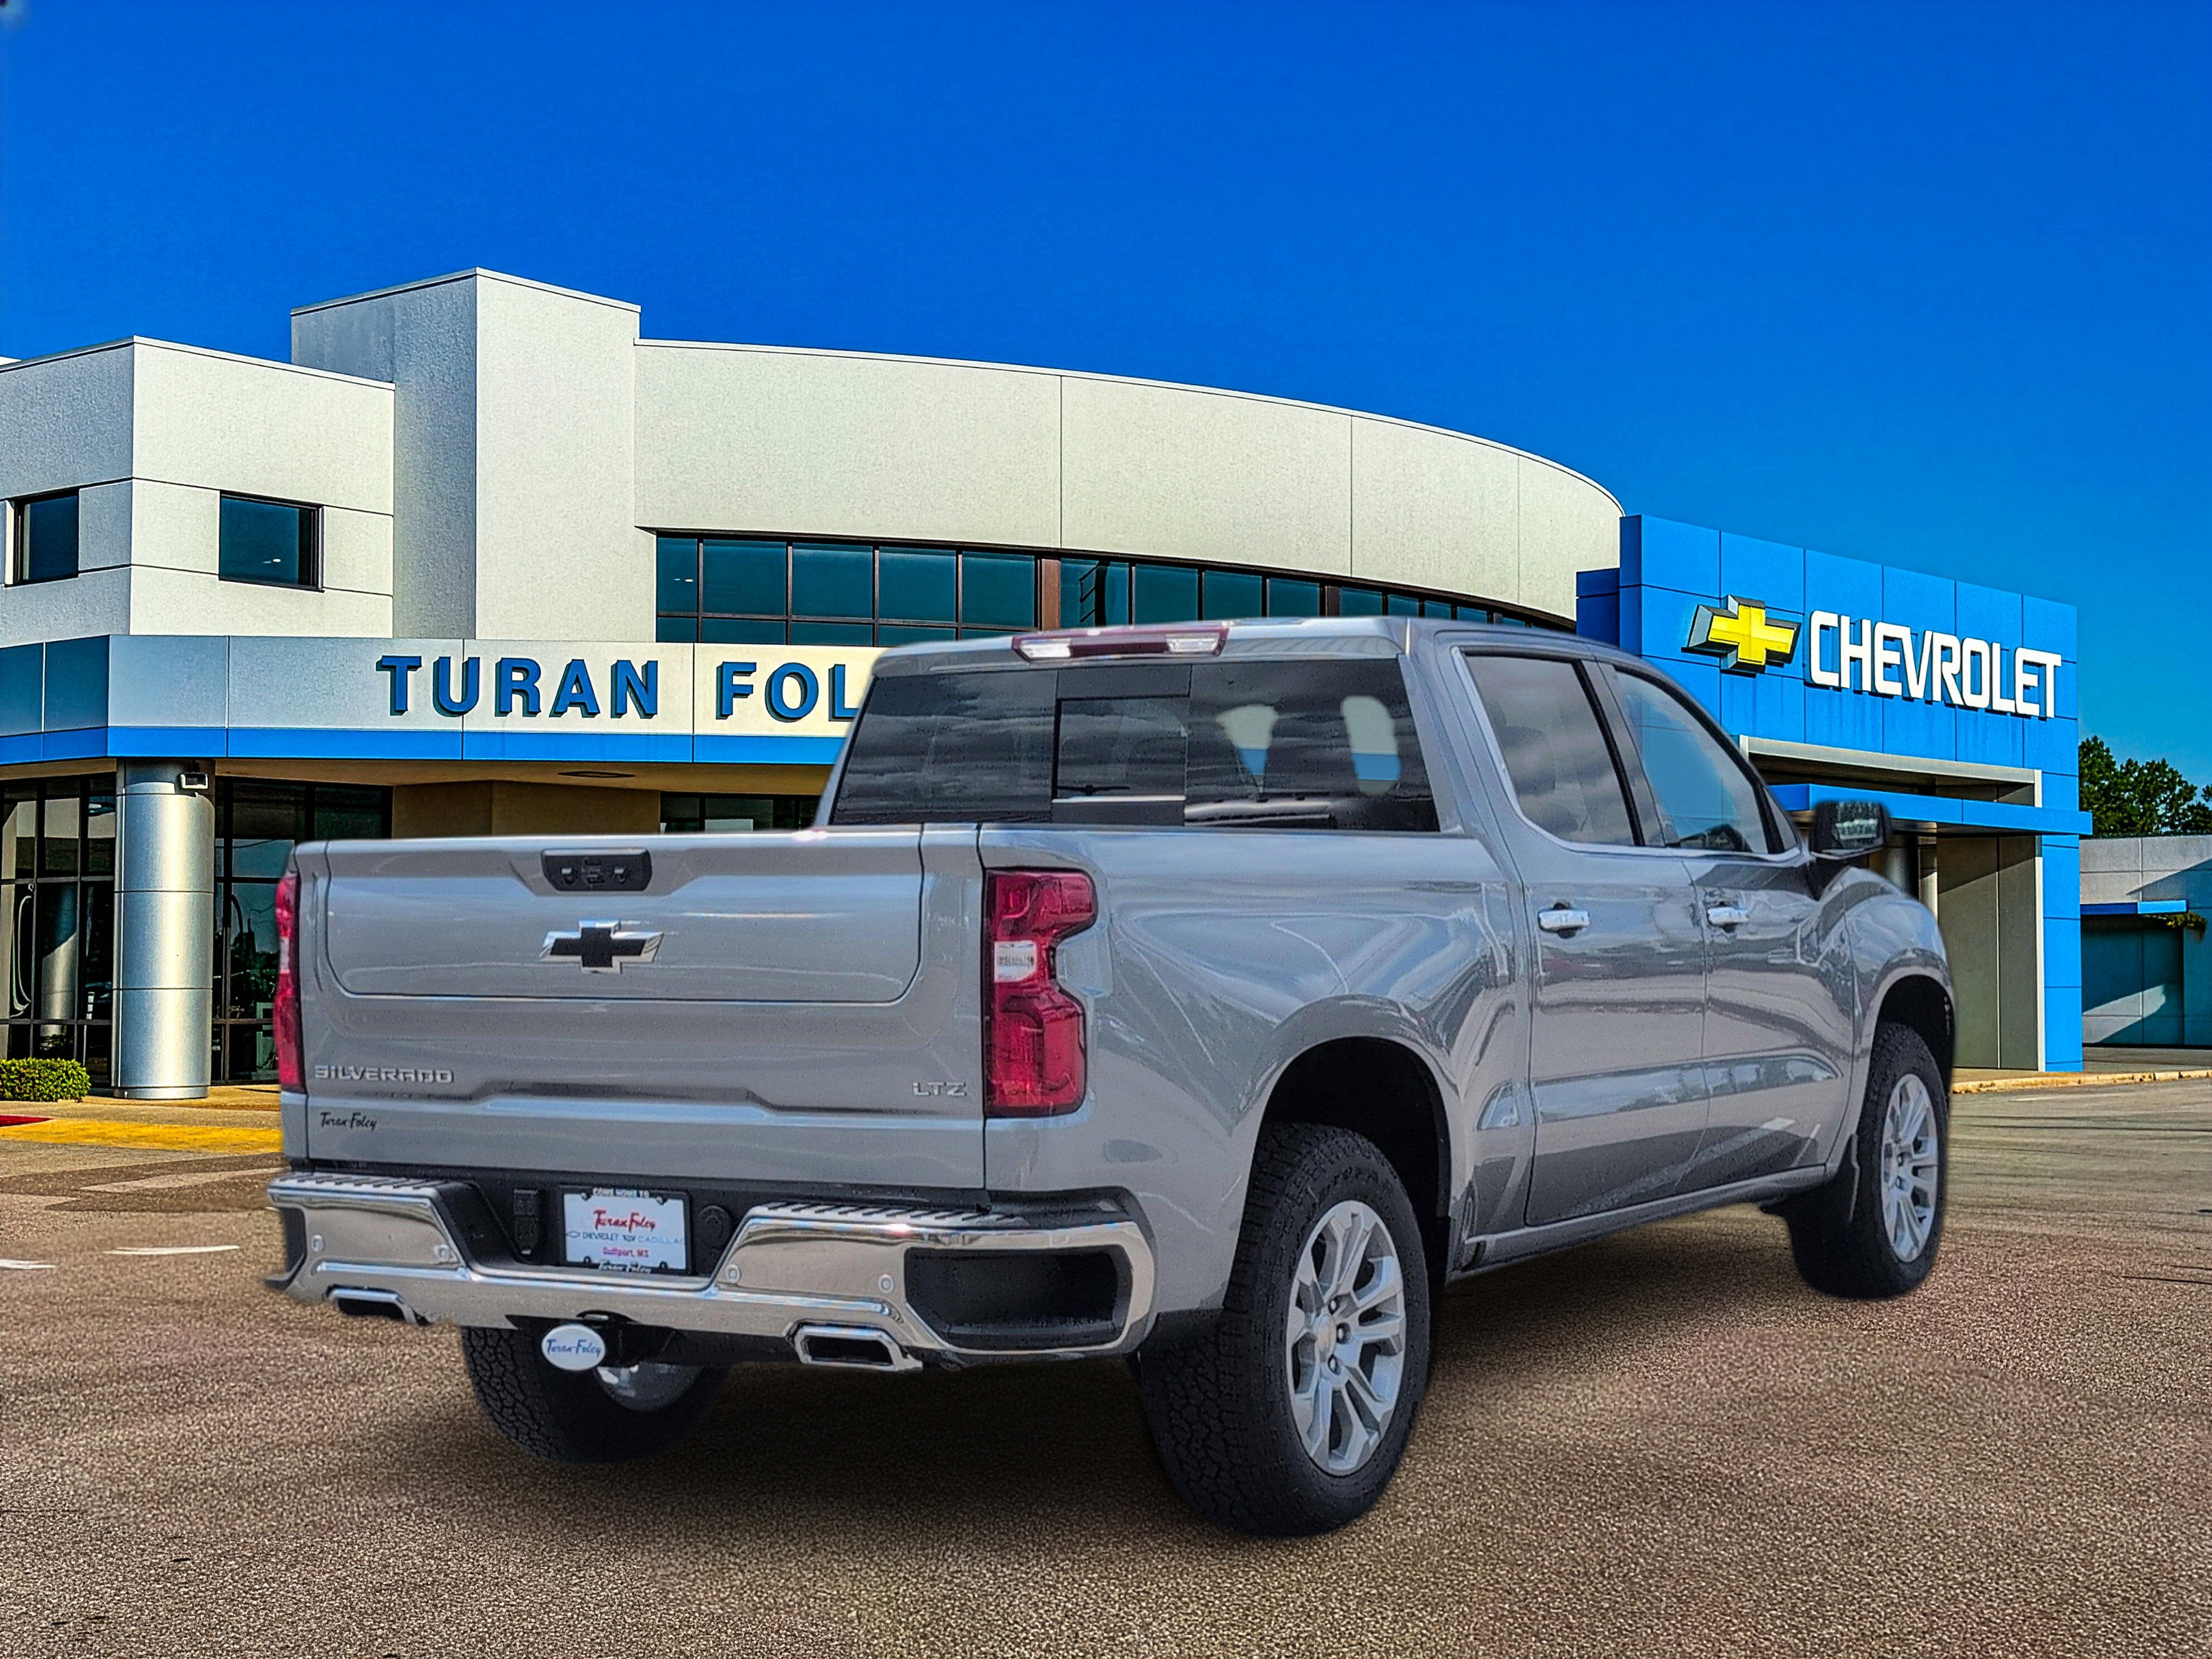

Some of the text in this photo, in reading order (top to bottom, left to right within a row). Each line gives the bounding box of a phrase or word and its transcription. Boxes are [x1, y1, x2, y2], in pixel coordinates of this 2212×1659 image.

[1808, 610, 2062, 719] CHEVROLET
[376, 655, 861, 722] TURAN FOL
[314, 1065, 454, 1083] SILVERADO
[912, 1081, 967, 1097] LTZ
